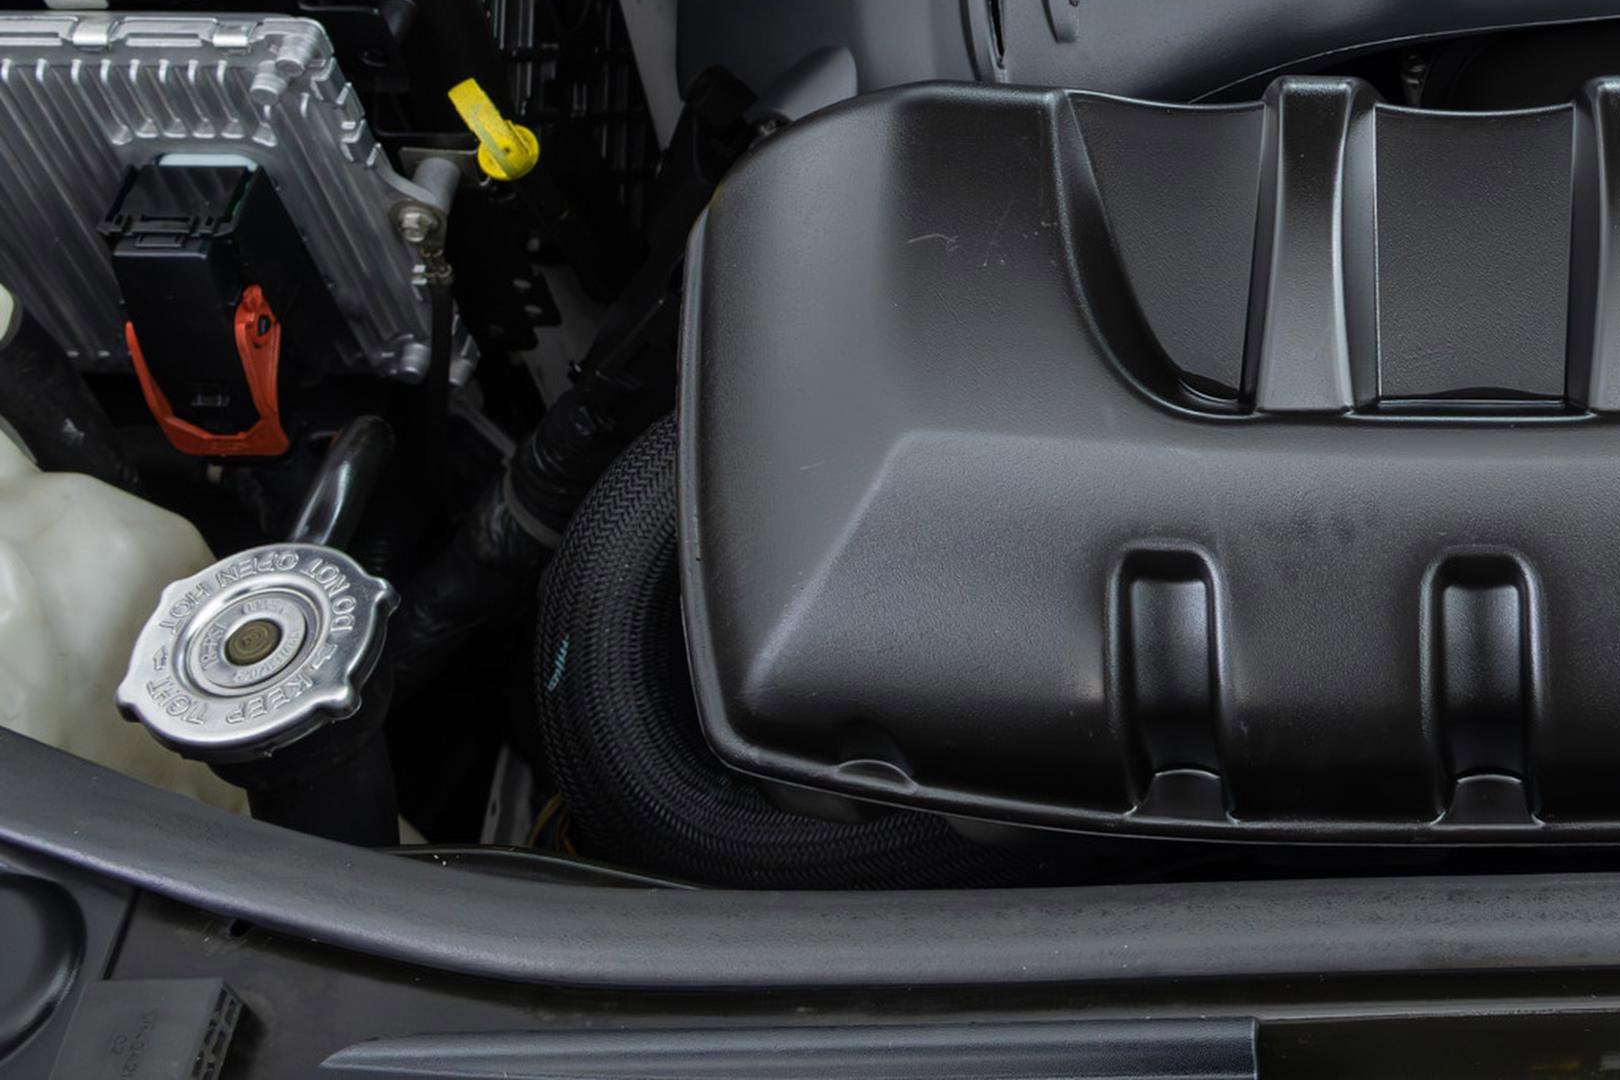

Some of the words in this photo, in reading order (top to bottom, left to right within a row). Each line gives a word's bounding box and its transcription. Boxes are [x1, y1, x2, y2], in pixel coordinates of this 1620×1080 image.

[216, 551, 300, 588] OPEN
[303, 557, 352, 597] NOT
[159, 583, 210, 635] HOT
[331, 596, 357, 632] DO
[146, 676, 206, 725] TIGHT
[226, 674, 313, 725] KEEP
